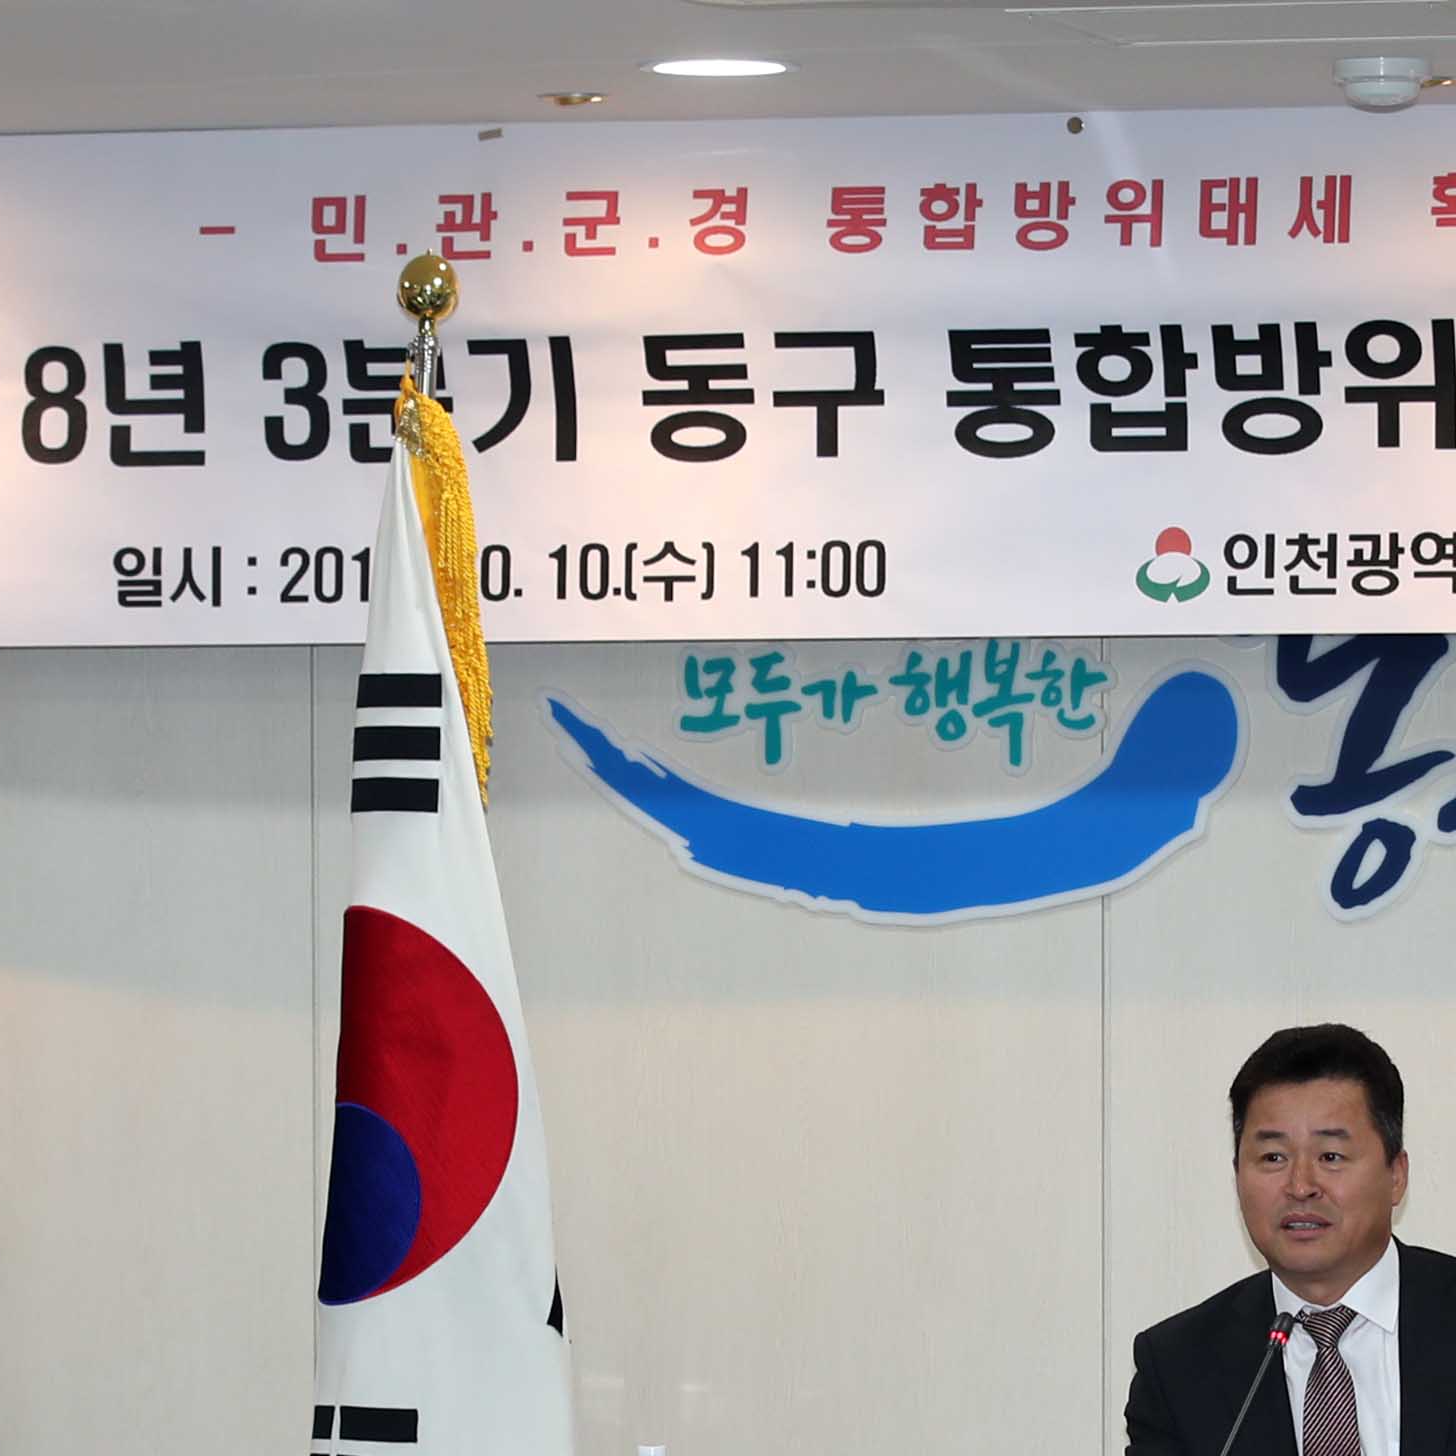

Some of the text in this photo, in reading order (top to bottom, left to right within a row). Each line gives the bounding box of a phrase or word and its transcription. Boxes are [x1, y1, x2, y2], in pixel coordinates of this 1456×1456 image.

[826, 177, 1353, 254] 통합방위태세
[642, 331, 886, 464] 동구
[113, 547, 223, 609] 일시
[280, 547, 372, 604] 201
[480, 545, 524, 603] 0.
[742, 540, 887, 599] 11:00
[681, 648, 866, 764] 모두가
[892, 639, 1108, 766] 행복한
